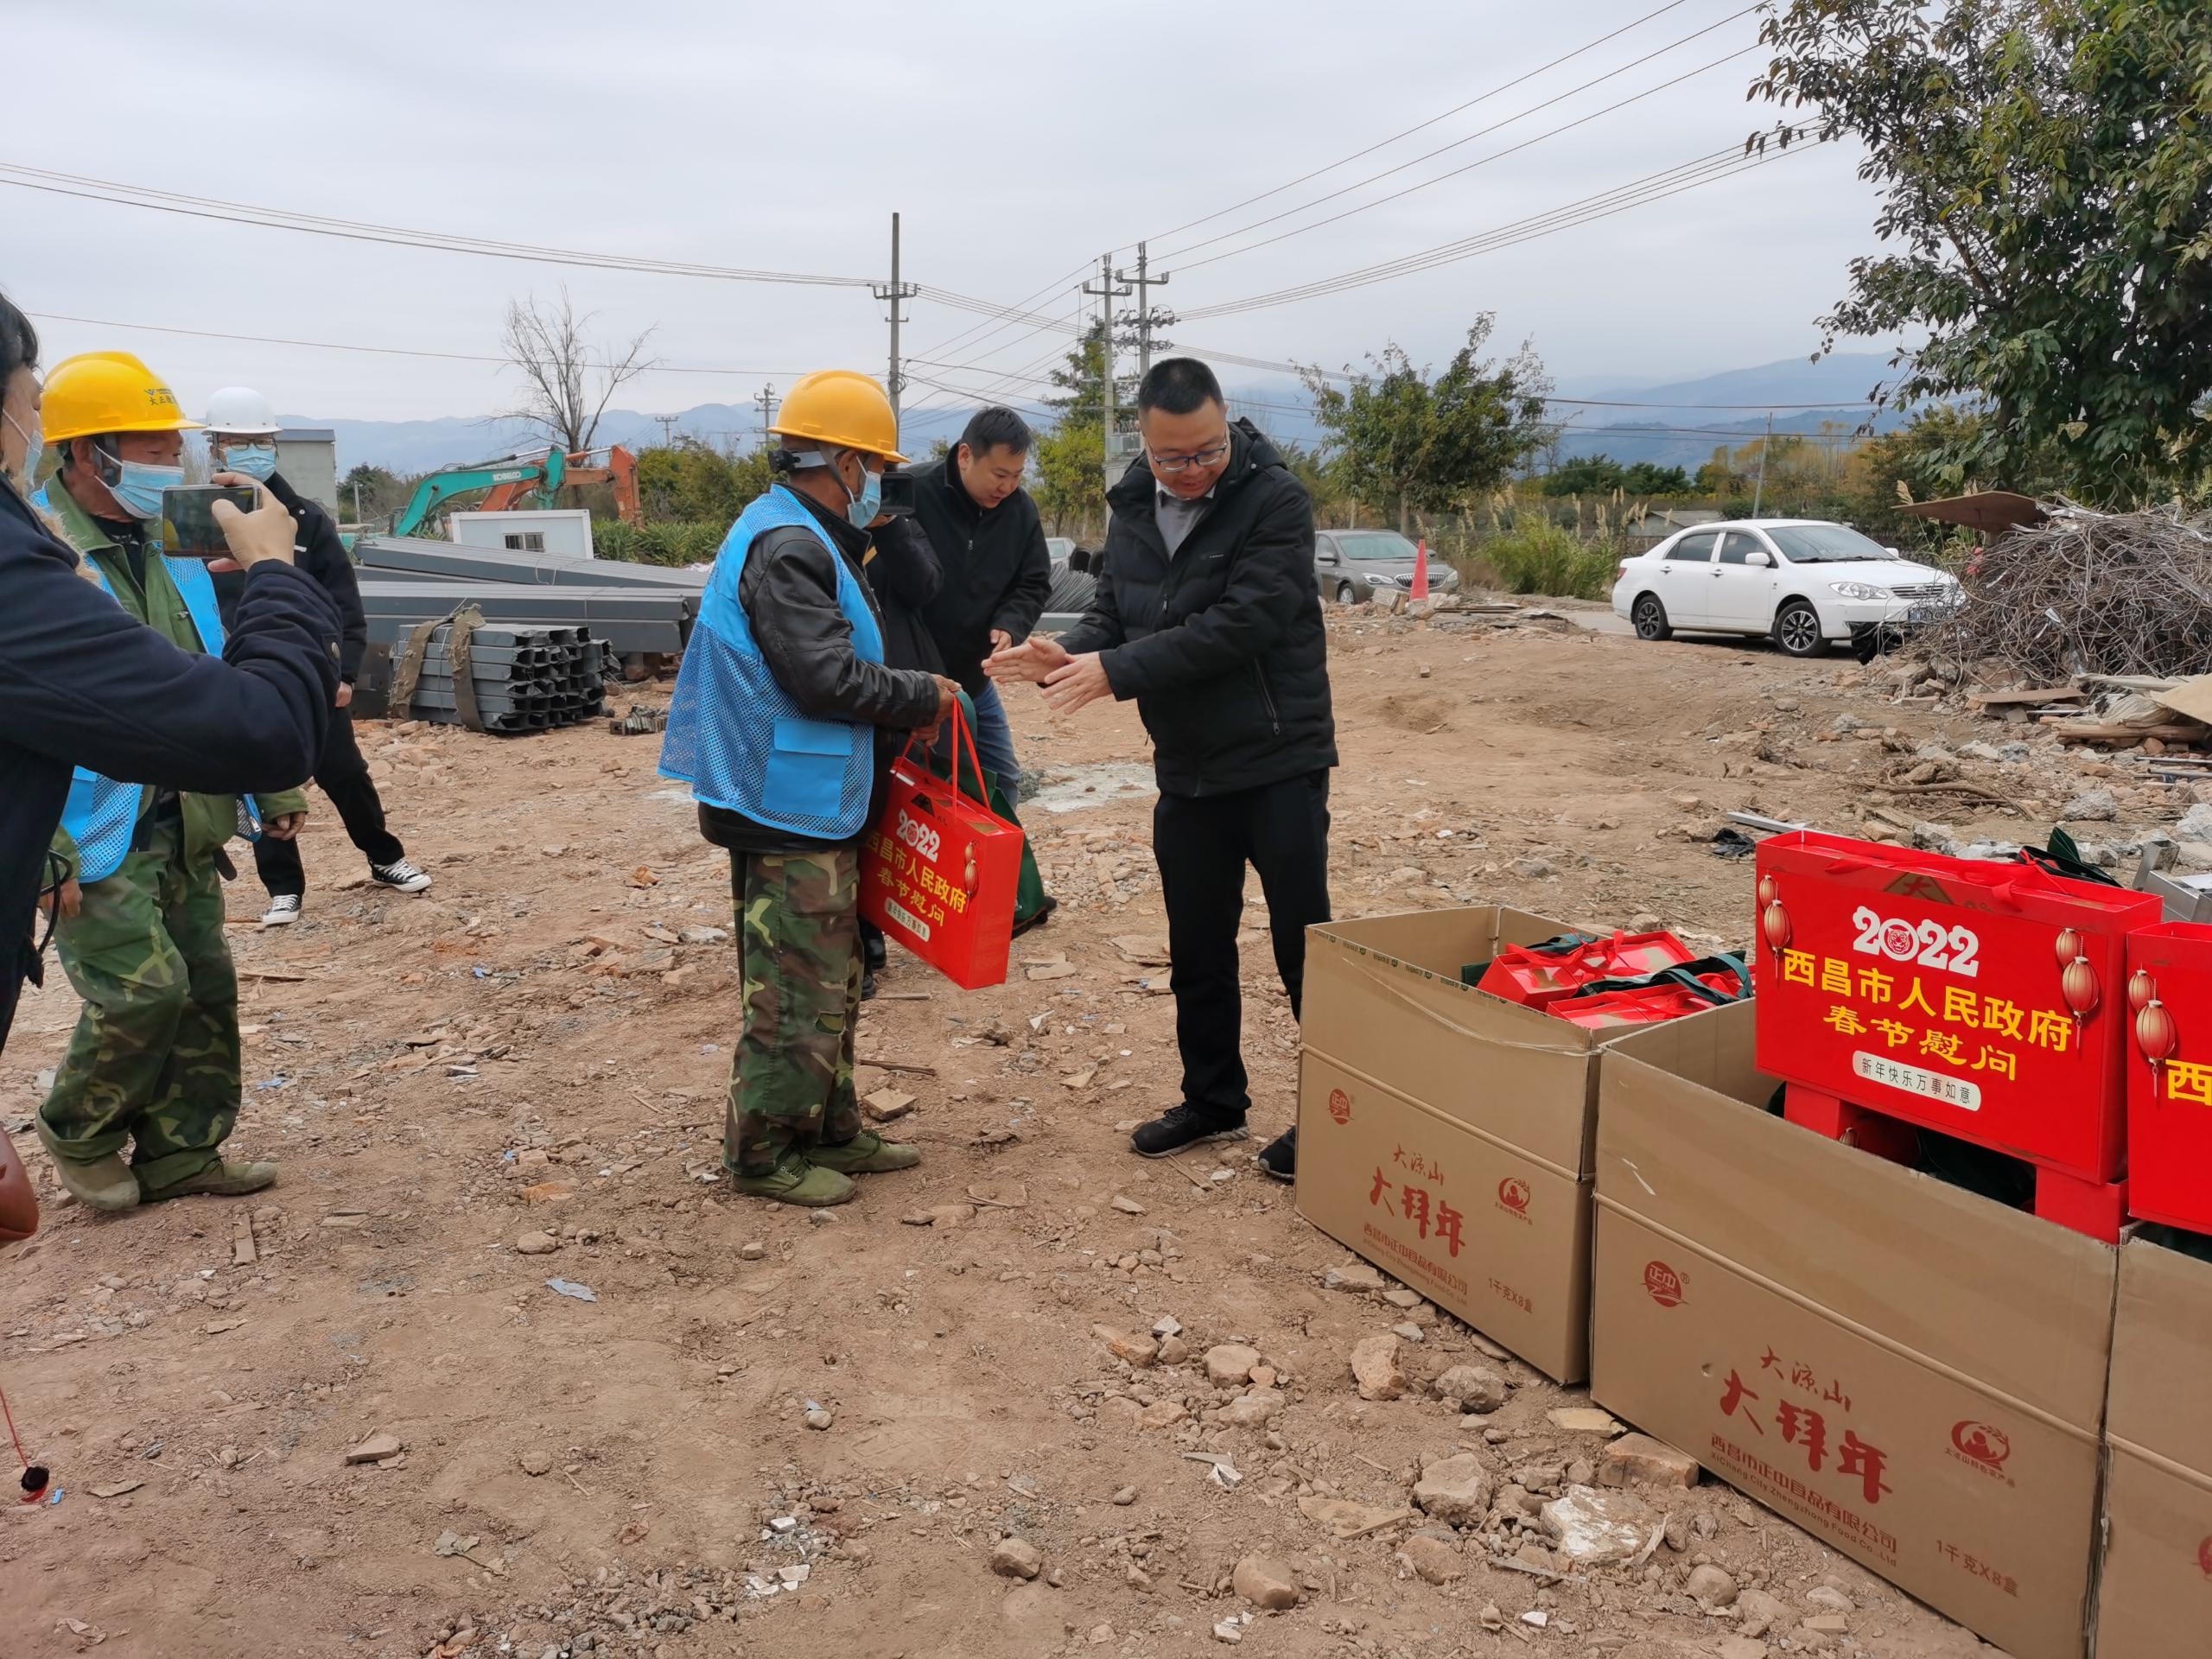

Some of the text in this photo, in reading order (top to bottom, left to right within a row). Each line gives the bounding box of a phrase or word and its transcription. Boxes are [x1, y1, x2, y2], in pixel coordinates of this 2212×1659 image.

[868, 831, 967, 913] 西昌市人民政府
[896, 808, 941, 862] 2022
[877, 867, 944, 927] 春节慰问
[1853, 905, 1980, 977] 2022
[1783, 948, 2073, 1052] 西昌市人民政府
[1822, 1005, 2017, 1081] 春节慰问
[1861, 1057, 1971, 1104] 新年快乐万事如意
[2165, 1058, 2212, 1106] 西
[1370, 1166, 1465, 1258] 大拜年
[1719, 1368, 1893, 1504] 大拜年
